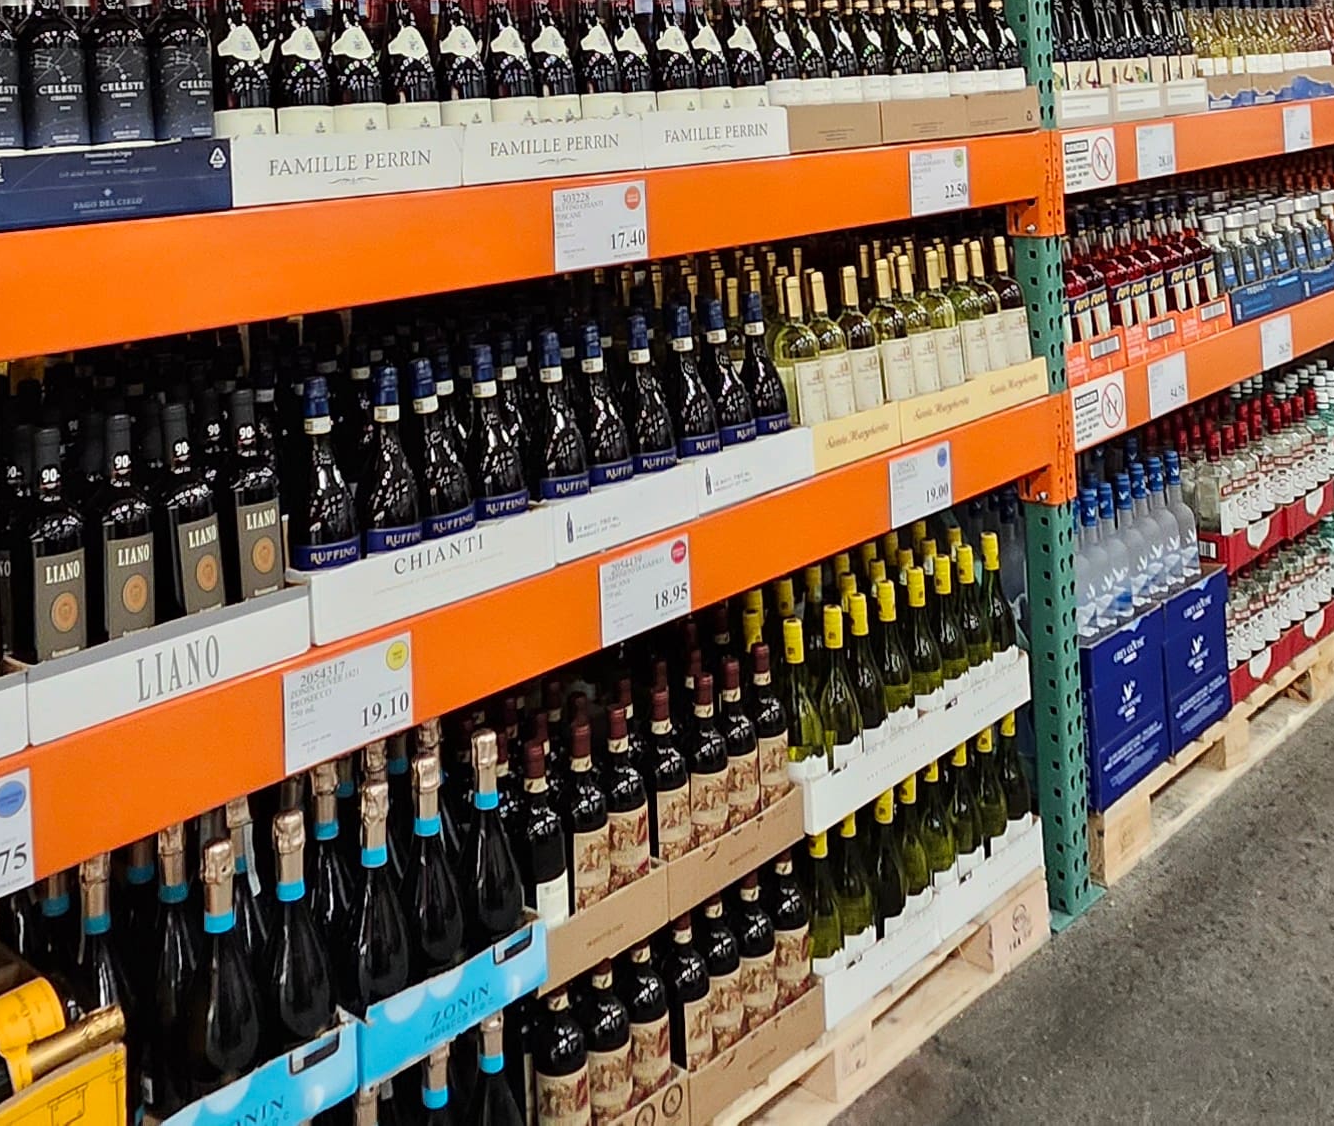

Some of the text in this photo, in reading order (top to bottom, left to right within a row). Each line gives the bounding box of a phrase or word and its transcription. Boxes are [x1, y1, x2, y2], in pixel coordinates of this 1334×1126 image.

[664, 123, 769, 143] FAMILLE PERRIN
[490, 133, 620, 157] FAMILLE PERRIN
[268, 149, 432, 177] FAMILLE PERRIN
[944, 182, 967, 199] 22.50
[73, 197, 142, 211] PAGO DEL CIELO
[611, 228, 646, 250] 17.40
[556, 478, 589, 494] RUFFIN
[926, 481, 949, 503] 19.00
[485, 496, 526, 513] RUFFINO
[246, 508, 276, 531] LIANO
[432, 513, 474, 532] RUFFINO
[188, 524, 217, 549] LIANO
[385, 529, 421, 546] RUFFIN
[117, 543, 150, 567] LIANO
[310, 545, 357, 564] RUFFINO
[394, 533, 484, 575] CHIANTI
[45, 559, 80, 585] LIANO
[654, 581, 688, 610] 18.95
[135, 633, 220, 703] LIANO
[300, 661, 346, 688] 2054317
[362, 691, 410, 727] 19.10
[431, 981, 491, 1028] ZONIN
